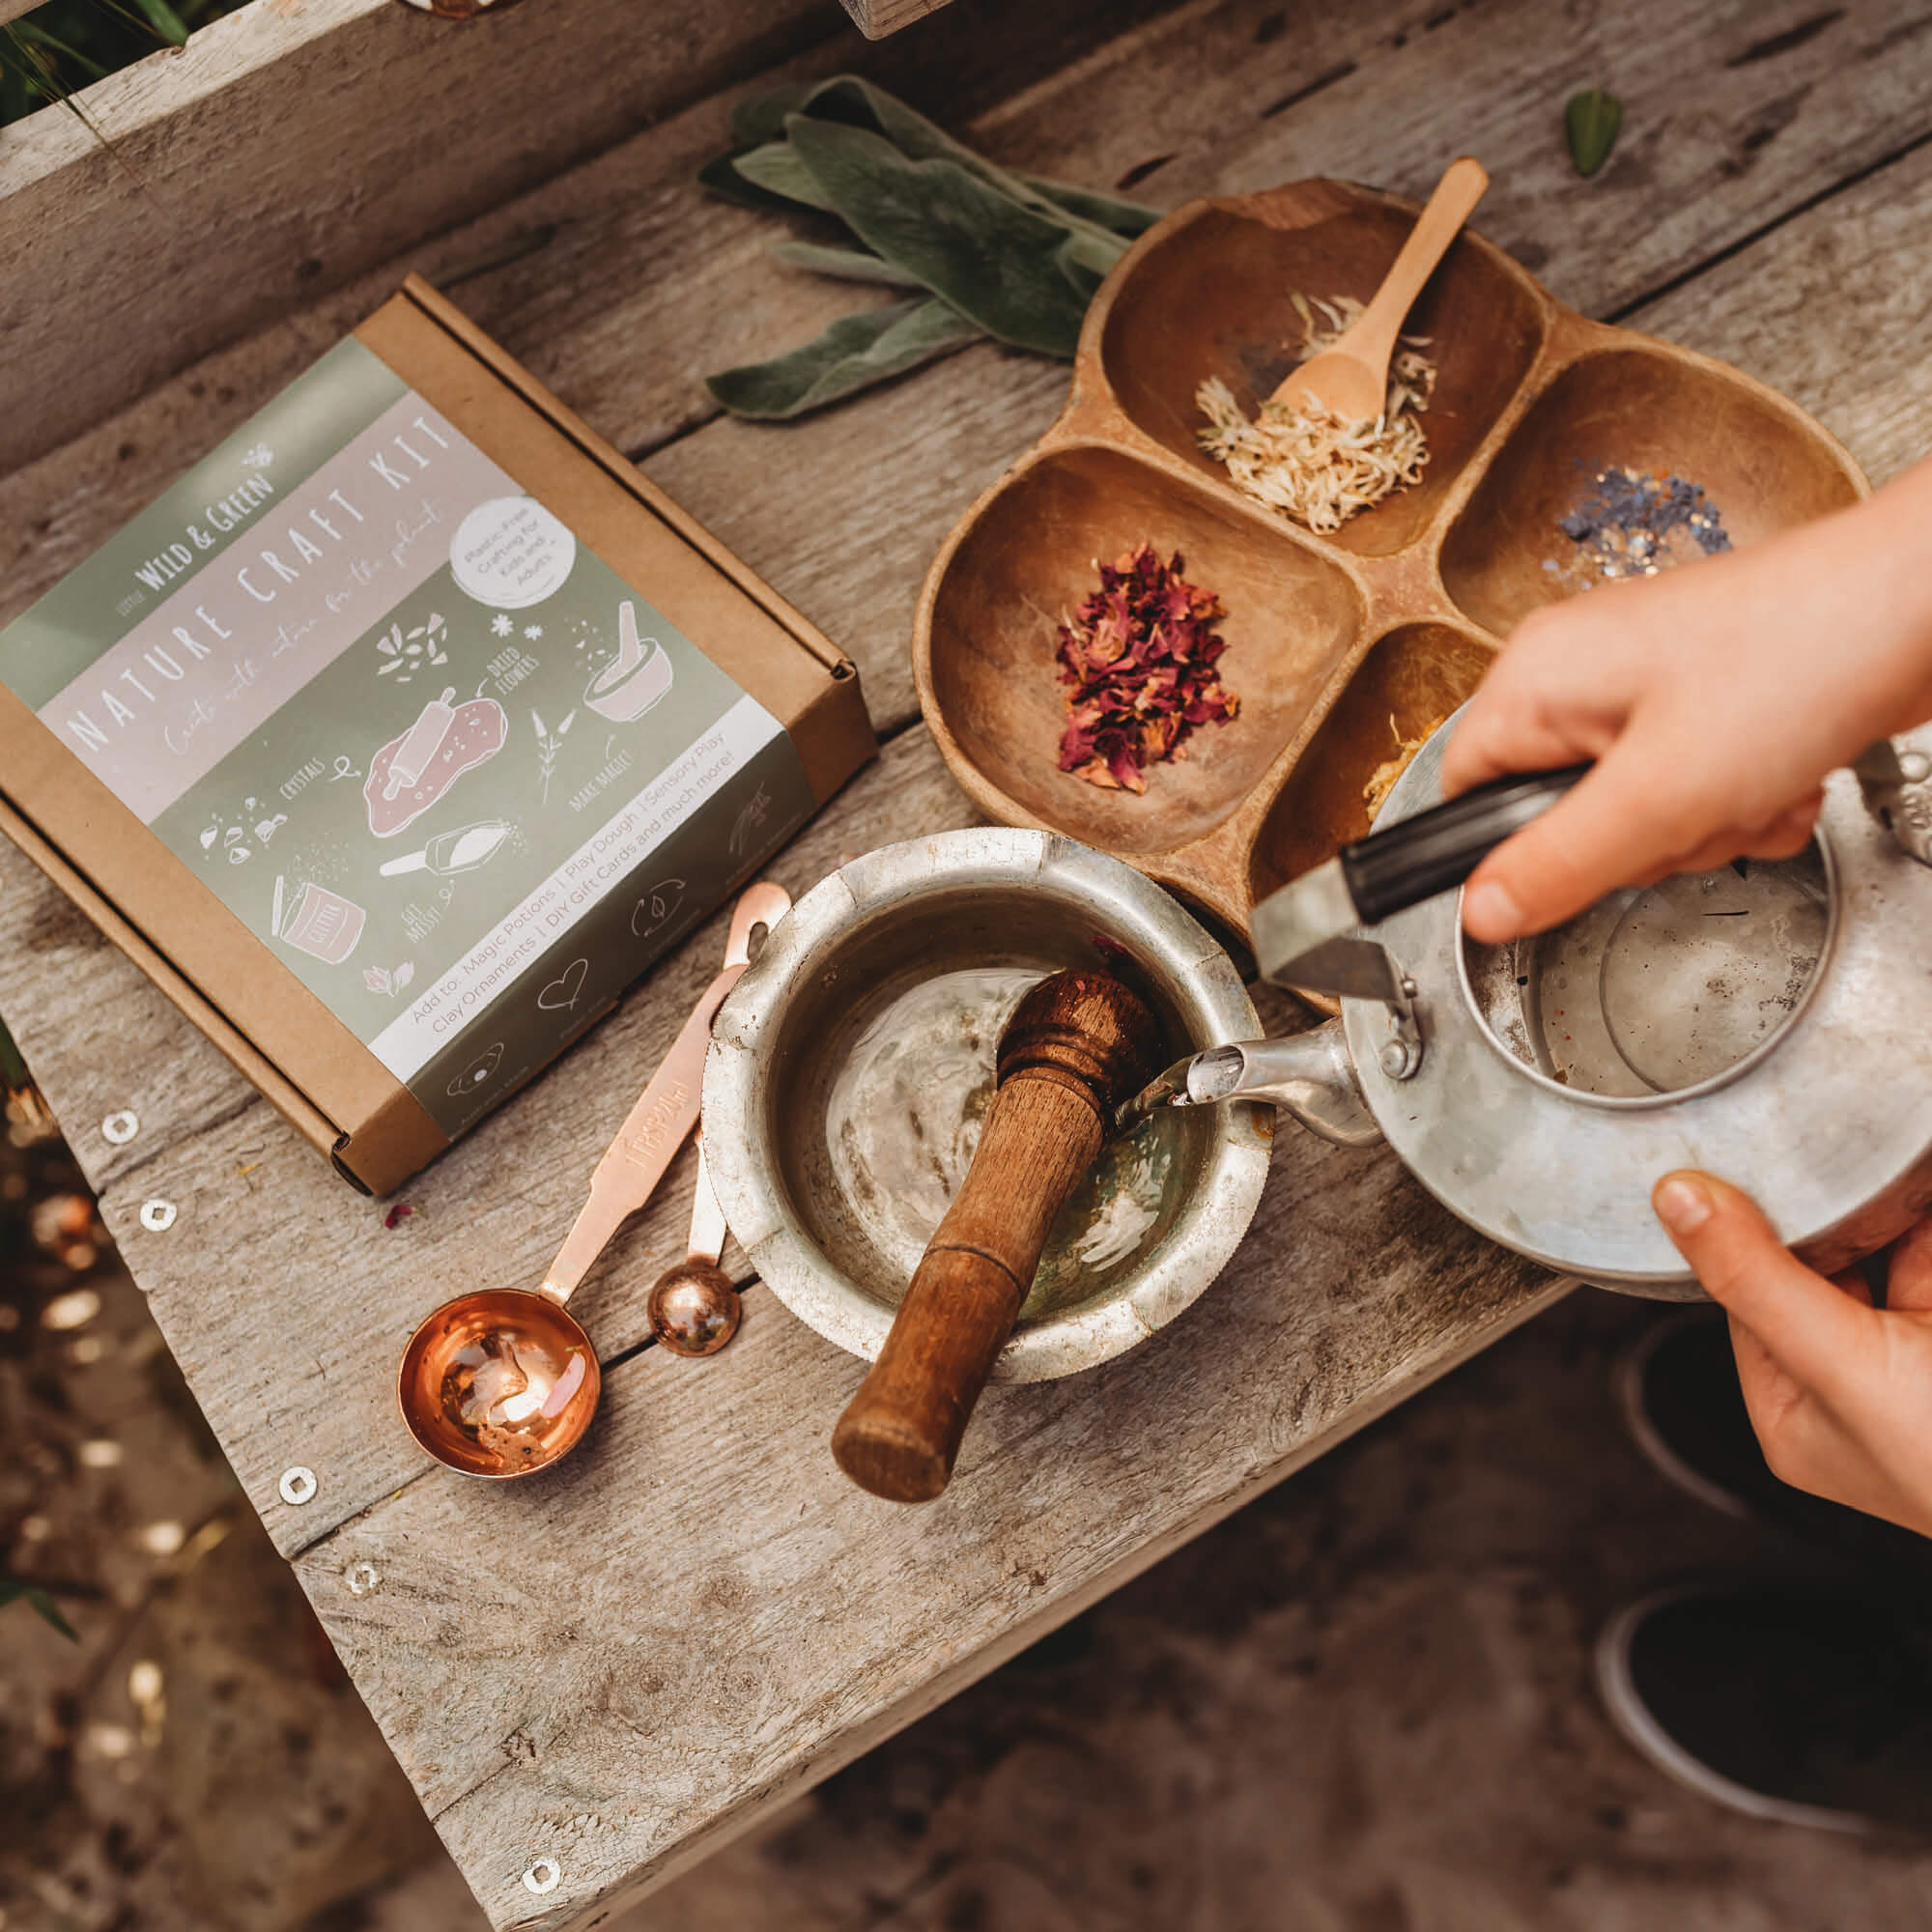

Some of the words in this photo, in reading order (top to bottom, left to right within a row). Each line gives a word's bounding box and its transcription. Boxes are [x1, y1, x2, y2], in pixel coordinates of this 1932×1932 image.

[134, 543, 193, 591] WILD
[185, 515, 216, 541] &
[206, 472, 275, 532] GREEN
[67, 604, 233, 753] NATURE
[237, 489, 364, 603] CRAFT
[368, 416, 449, 490] KIT
[486, 646, 521, 677] DRIED
[494, 654, 541, 696] FLOWERS
[279, 756, 326, 801] CRYSTALS
[568, 781, 601, 812] MAKE
[412, 995, 441, 1024] Add
[463, 934, 508, 976] Magic
[502, 888, 556, 936] Potions
[564, 851, 597, 878] Play
[592, 810, 641, 855] Dough
[643, 755, 697, 806] Sensory
[695, 732, 727, 758] Play
[432, 1002, 466, 1035] Clay
[461, 936, 537, 1007] Ornaments
[545, 898, 573, 928] DIY
[570, 873, 601, 906] Gift
[595, 842, 638, 880] Cards
[636, 817, 663, 847] and
[661, 785, 699, 821] much
[696, 751, 736, 790] more!
